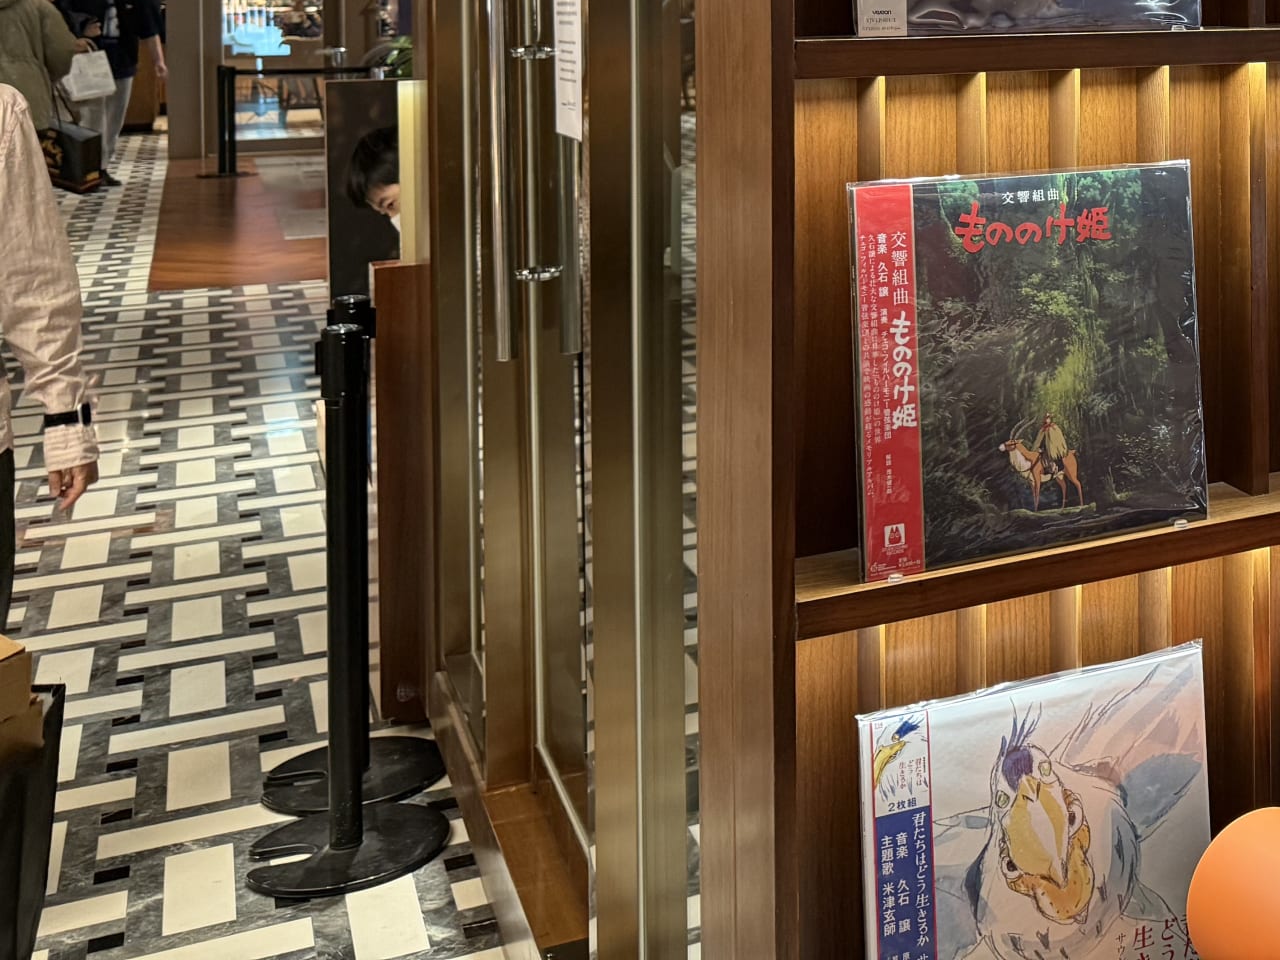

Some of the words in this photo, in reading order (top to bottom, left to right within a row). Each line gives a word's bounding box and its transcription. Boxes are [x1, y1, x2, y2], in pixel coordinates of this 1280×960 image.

[1002, 188, 1060, 205] 交響組曲
[954, 201, 1112, 254] もののけ姫
[877, 233, 888, 254] 音楽
[891, 231, 909, 306] 交響組曲
[889, 310, 918, 429] もののけ姫
[887, 797, 917, 813] 2枚組
[880, 835, 895, 877] 主題歌
[896, 832, 909, 859] 音楽
[897, 879, 911, 906] 久石
[911, 811, 930, 947] 君たちはどう生きるか
[882, 882, 896, 938] 米津玄師
[898, 919, 911, 934] 譲
[1115, 933, 1126, 960] サウ
